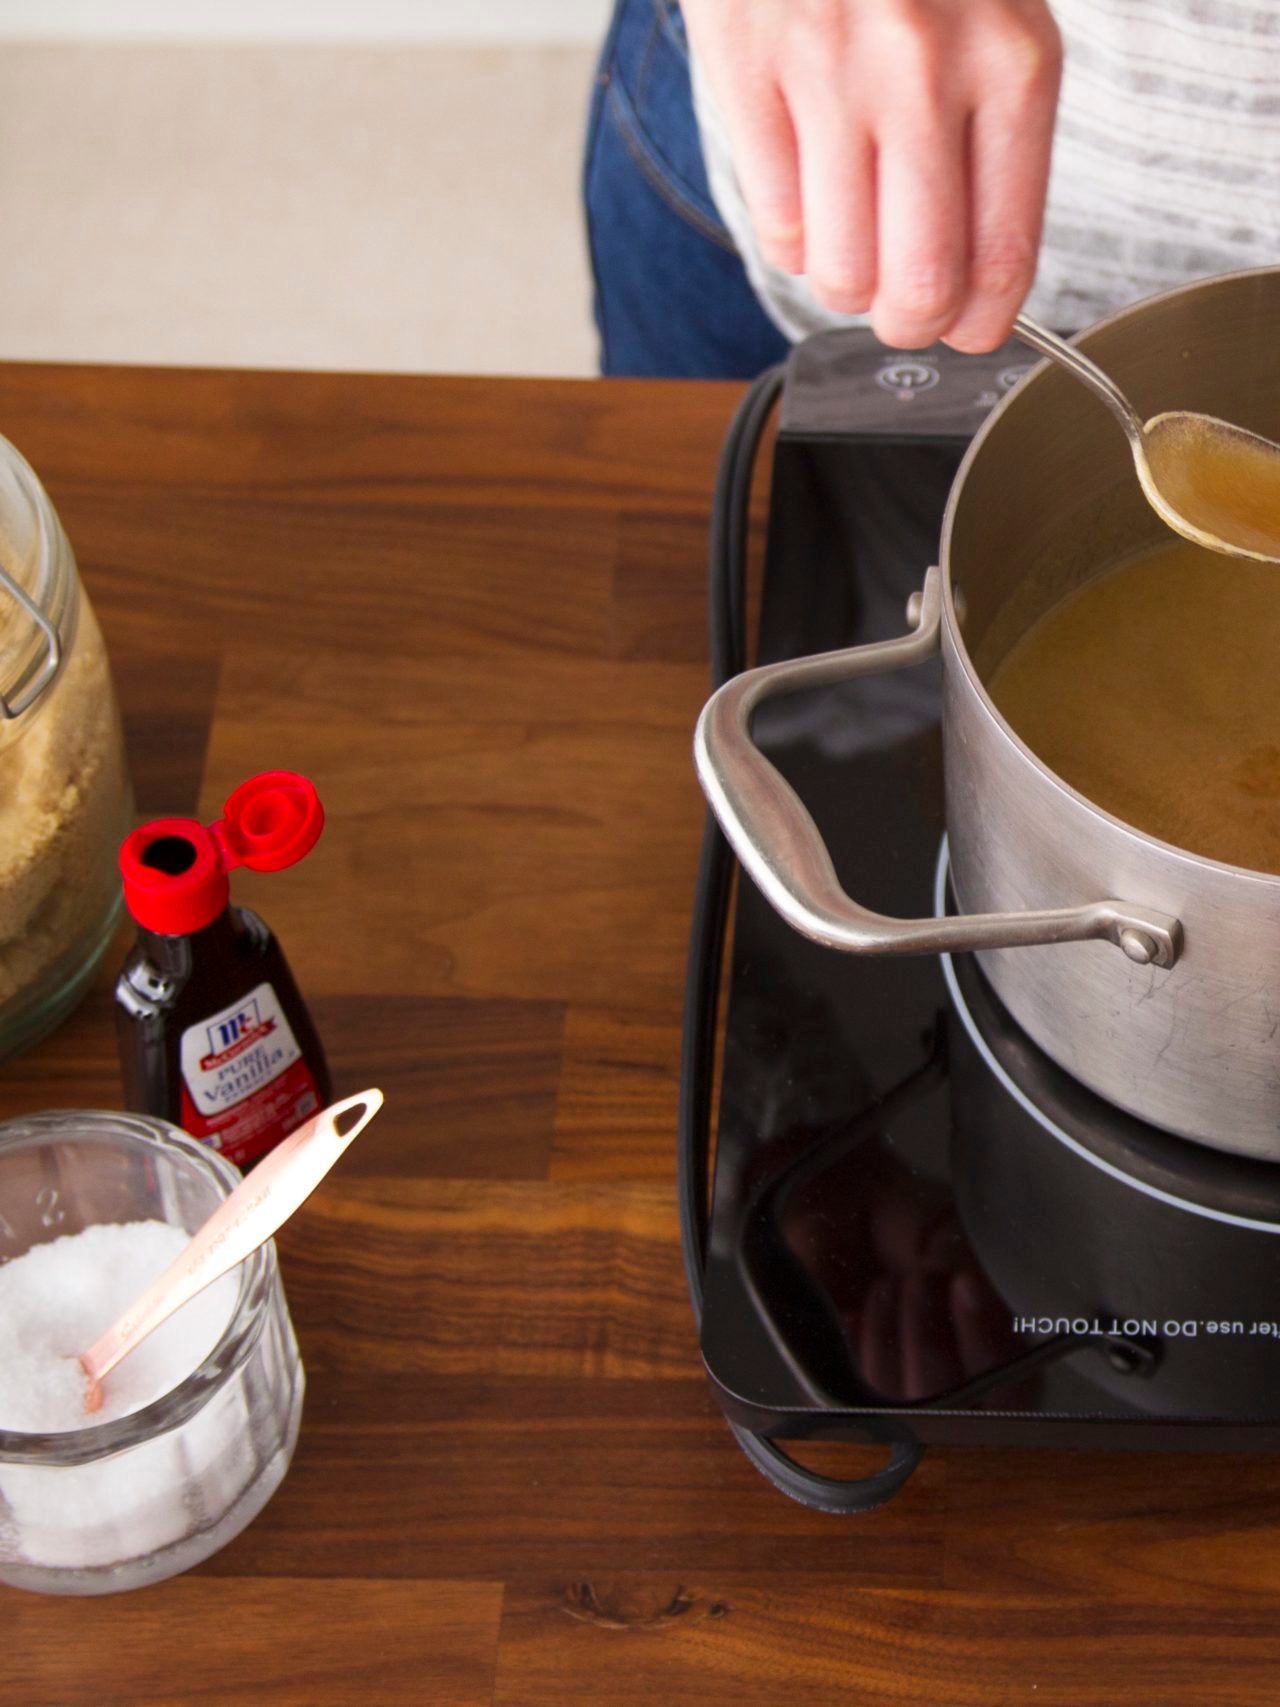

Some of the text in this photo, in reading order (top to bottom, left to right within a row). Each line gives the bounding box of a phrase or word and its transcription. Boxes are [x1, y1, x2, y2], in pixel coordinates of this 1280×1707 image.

[204, 1048, 283, 1102] Vanilla
[218, 1045, 264, 1080] PURE
[1013, 1317, 1104, 1334] TOUCH!
[1108, 1319, 1157, 1335] NOT
